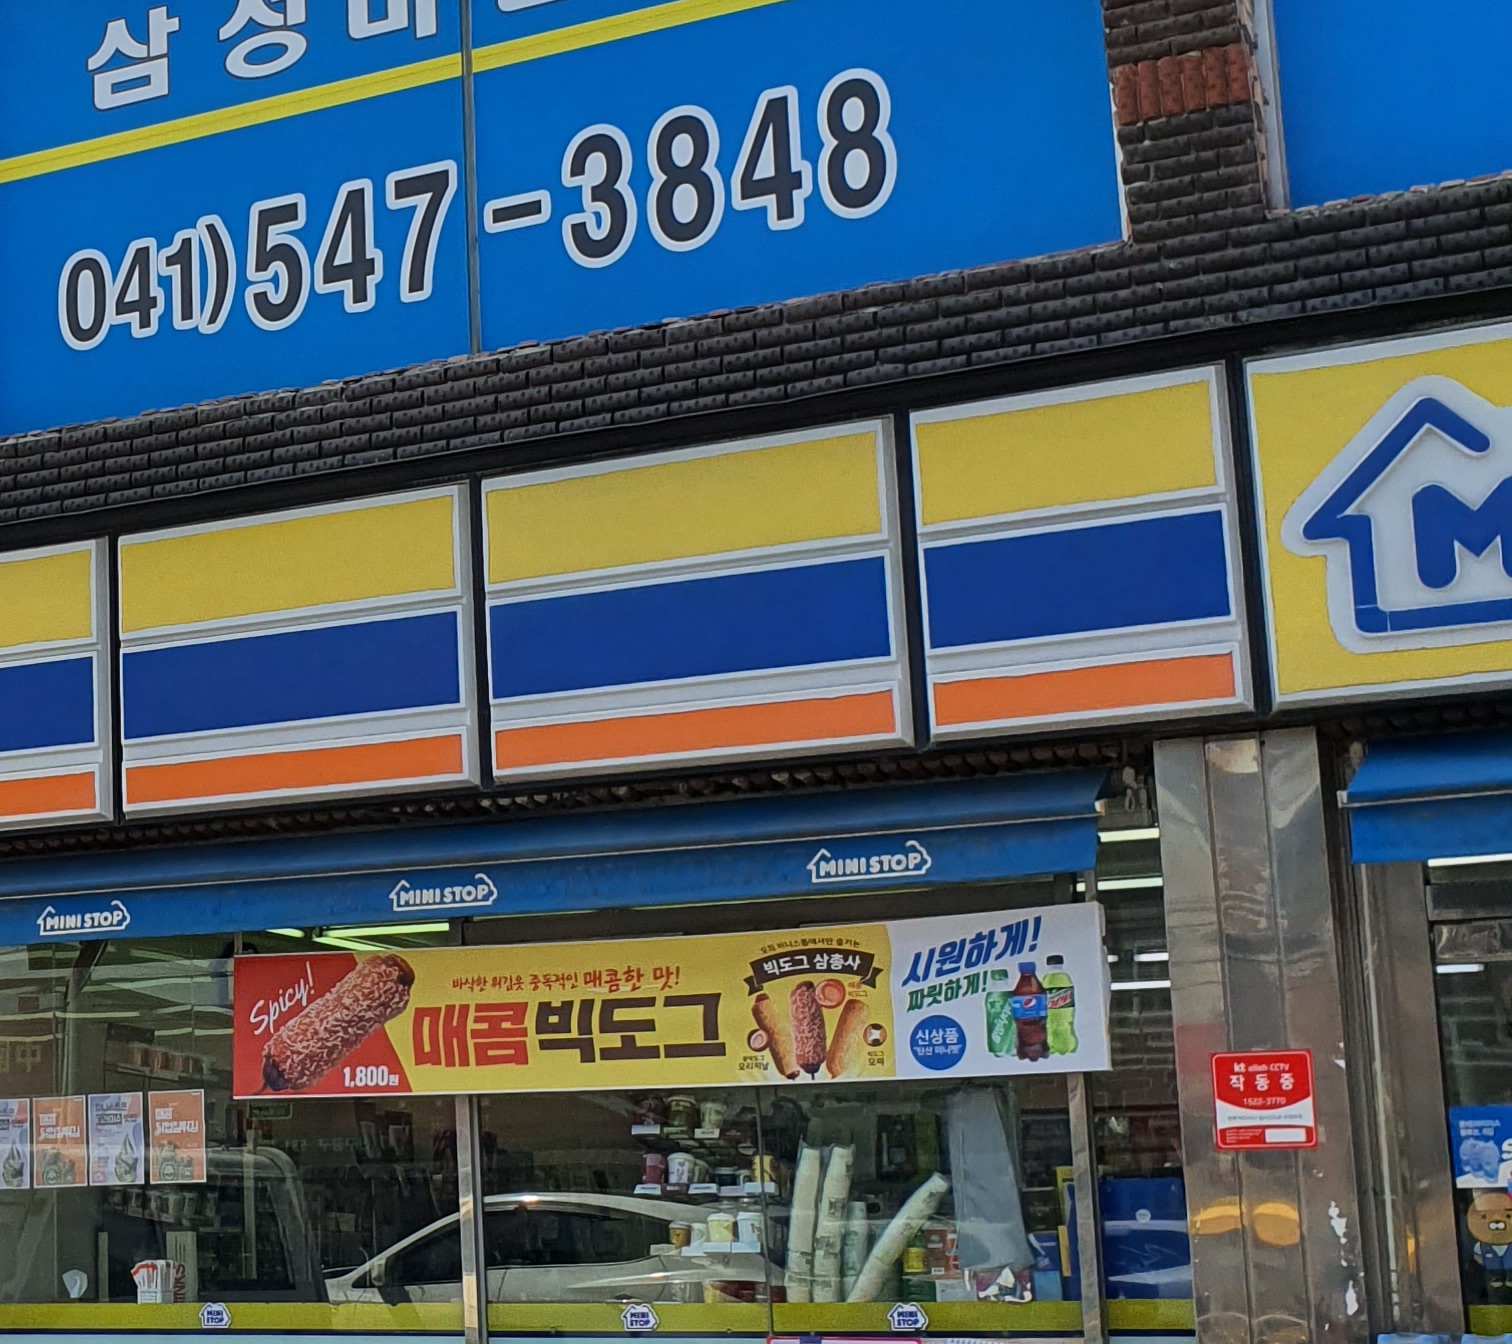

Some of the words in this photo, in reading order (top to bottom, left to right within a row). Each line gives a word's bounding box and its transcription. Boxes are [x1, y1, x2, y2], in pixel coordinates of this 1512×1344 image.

[59, 68, 897, 350] 041)547-3848
[867, 852, 923, 875] STOP
[441, 883, 488, 904] STOP
[82, 908, 125, 929] STOP
[901, 915, 1042, 987] 시원하게!
[762, 955, 810, 976] 빅도그
[813, 952, 862, 971] 삼총사
[452, 974, 488, 993] 바삭한
[528, 971, 578, 992] 중독적인
[583, 965, 645, 993] 매콤한
[652, 965, 681, 992] 맛!
[249, 961, 316, 1037] Spicy!
[907, 970, 988, 1013] 짜릿하게!
[915, 1027, 960, 1044] 신상품
[1269, 1063, 1290, 1072] CCTV
